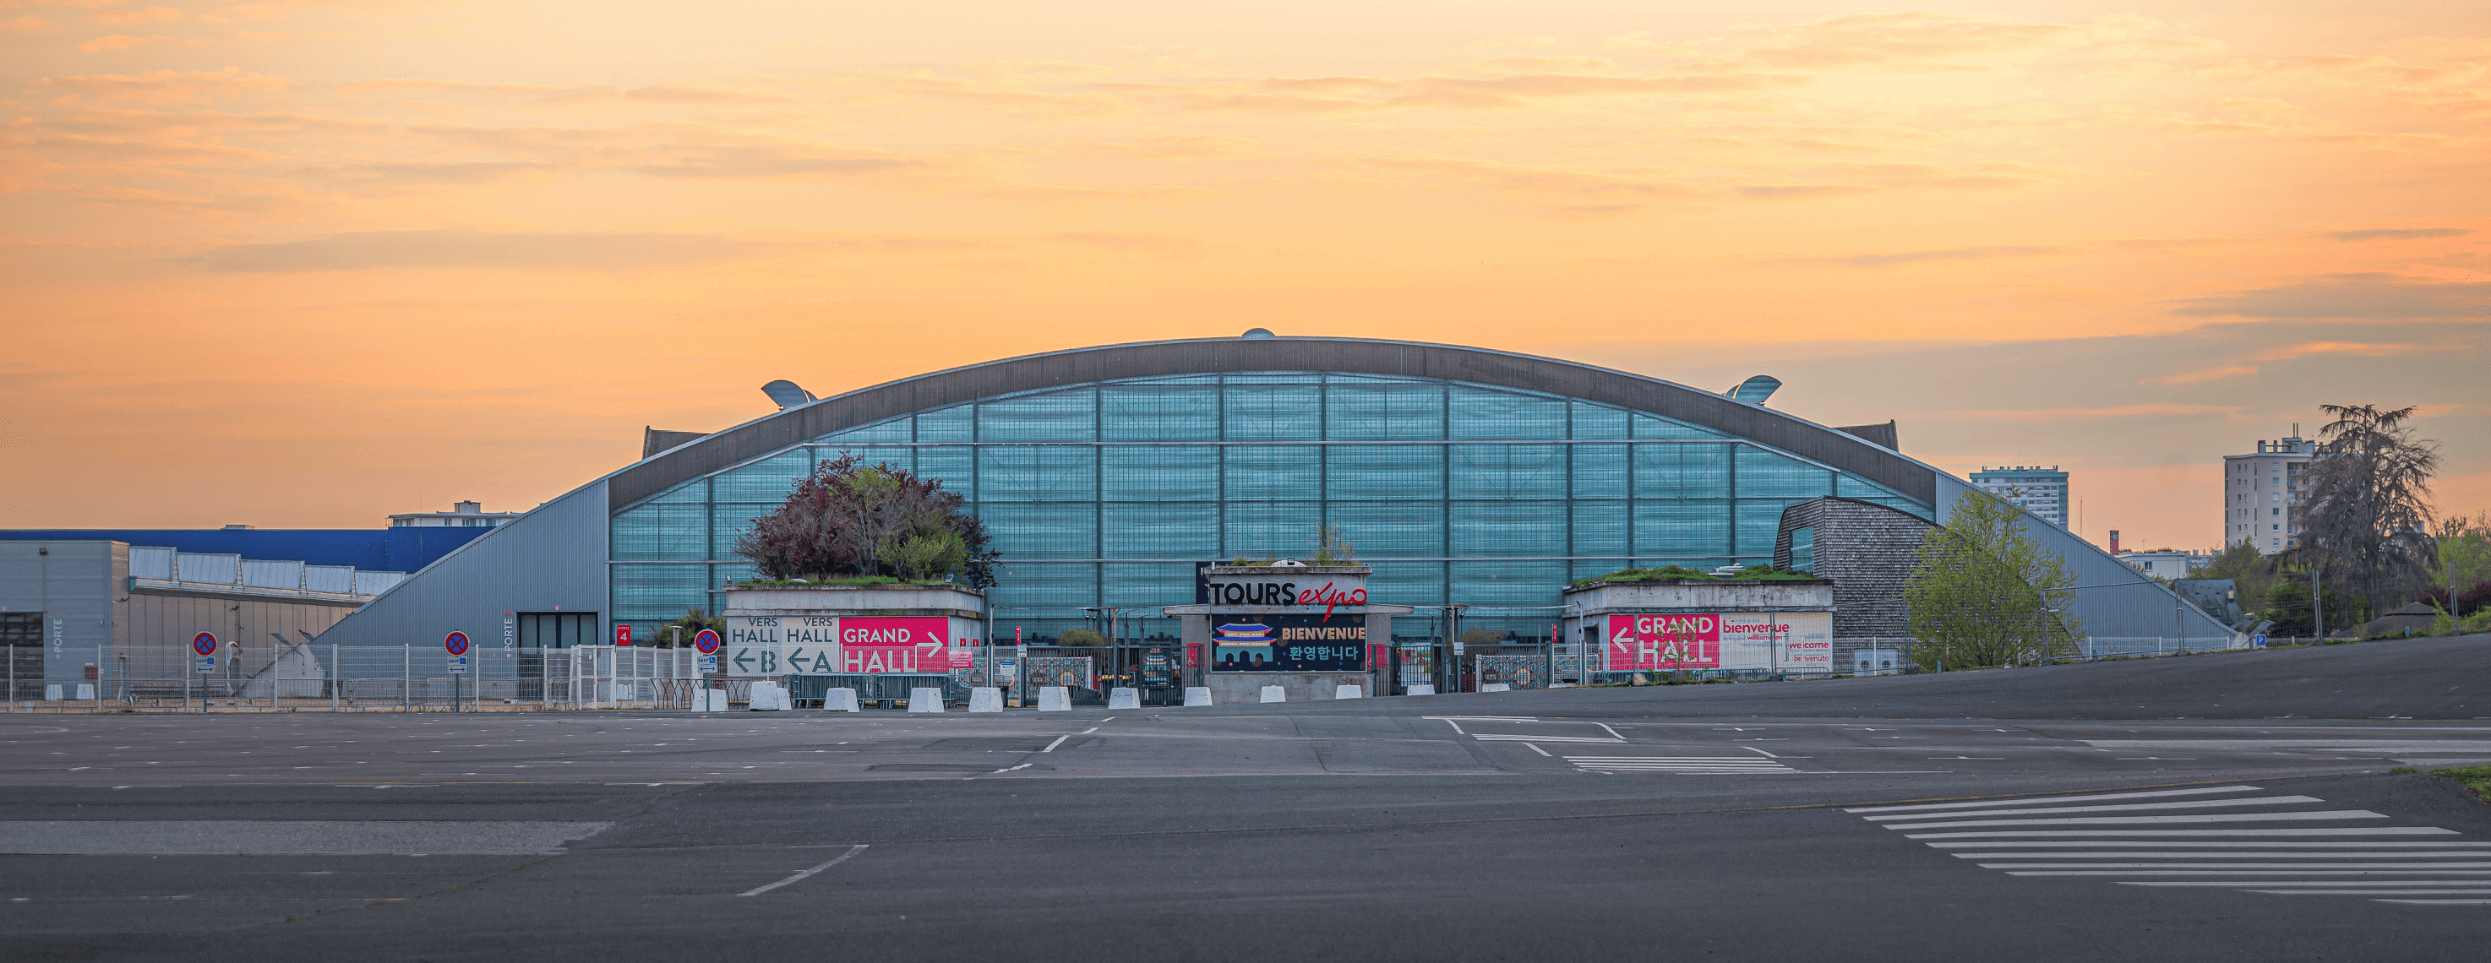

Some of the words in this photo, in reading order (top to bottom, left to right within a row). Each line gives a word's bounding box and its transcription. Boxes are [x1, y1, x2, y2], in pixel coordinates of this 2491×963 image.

[1210, 582, 1296, 605] TOURS
[1298, 581, 1368, 624] expo
[748, 617, 778, 627] VERS
[803, 617, 833, 627] VERS
[1638, 616, 1714, 634] GRAND
[53, 618, 62, 653] PORTE
[504, 618, 513, 652] PORTE
[620, 632, 628, 641] 4
[732, 629, 778, 642] HALL
[787, 629, 833, 642] HALL
[843, 628, 911, 643] GRAND
[1282, 627, 1366, 640] BIENVENUE
[1289, 645, 1359, 661] 환영합니다
[1638, 639, 1713, 663] HALL
[761, 651, 777, 673] B
[812, 650, 833, 673] A
[844, 650, 918, 673] HALL
